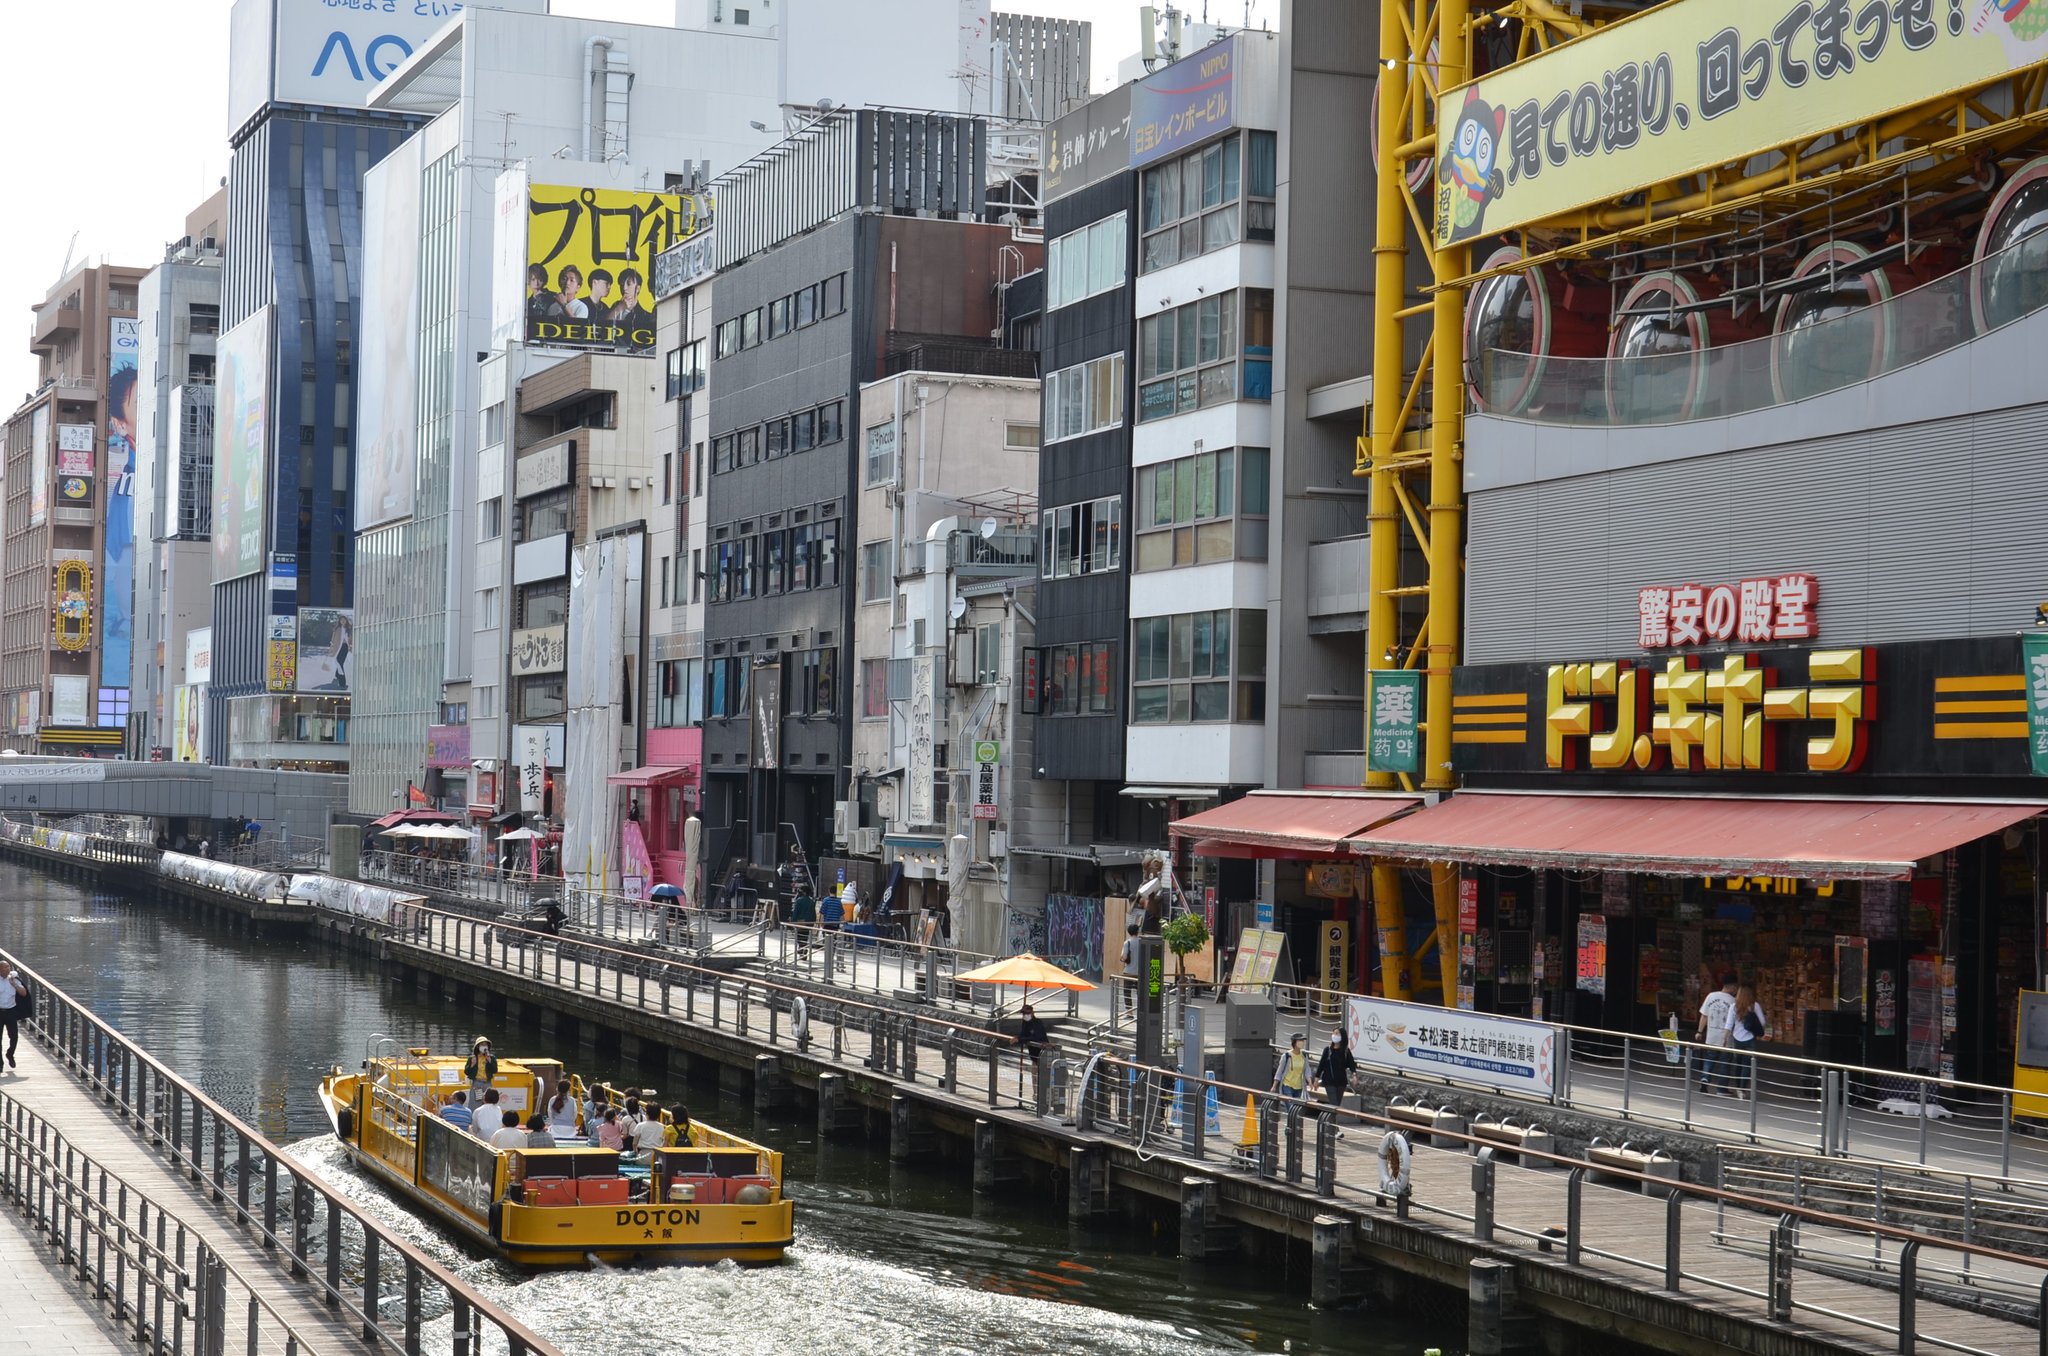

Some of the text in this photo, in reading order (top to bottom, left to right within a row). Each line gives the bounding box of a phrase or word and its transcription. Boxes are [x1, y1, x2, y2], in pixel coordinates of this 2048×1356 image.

[1200, 52, 1229, 80] NIPPO
[1135, 91, 1227, 155] 日宝レインボービル
[1061, 113, 1132, 171] 岩伸グループ
[535, 322, 625, 342] DEEP
[1638, 574, 1816, 647] 驚安の殿堂
[1376, 684, 1414, 726] 薬
[1373, 728, 1414, 737] Medicine
[1374, 738, 1391, 757] 药
[1396, 738, 1413, 757] 약
[523, 761, 542, 799] 歩兵
[979, 762, 994, 805] 瓦屋薬粧
[1438, 1053, 1453, 1064] Bridge
[1453, 1056, 1468, 1066] Wharf
[1460, 1034, 1535, 1063] 太左衛門橋船着場
[616, 1209, 700, 1226] DOTON
